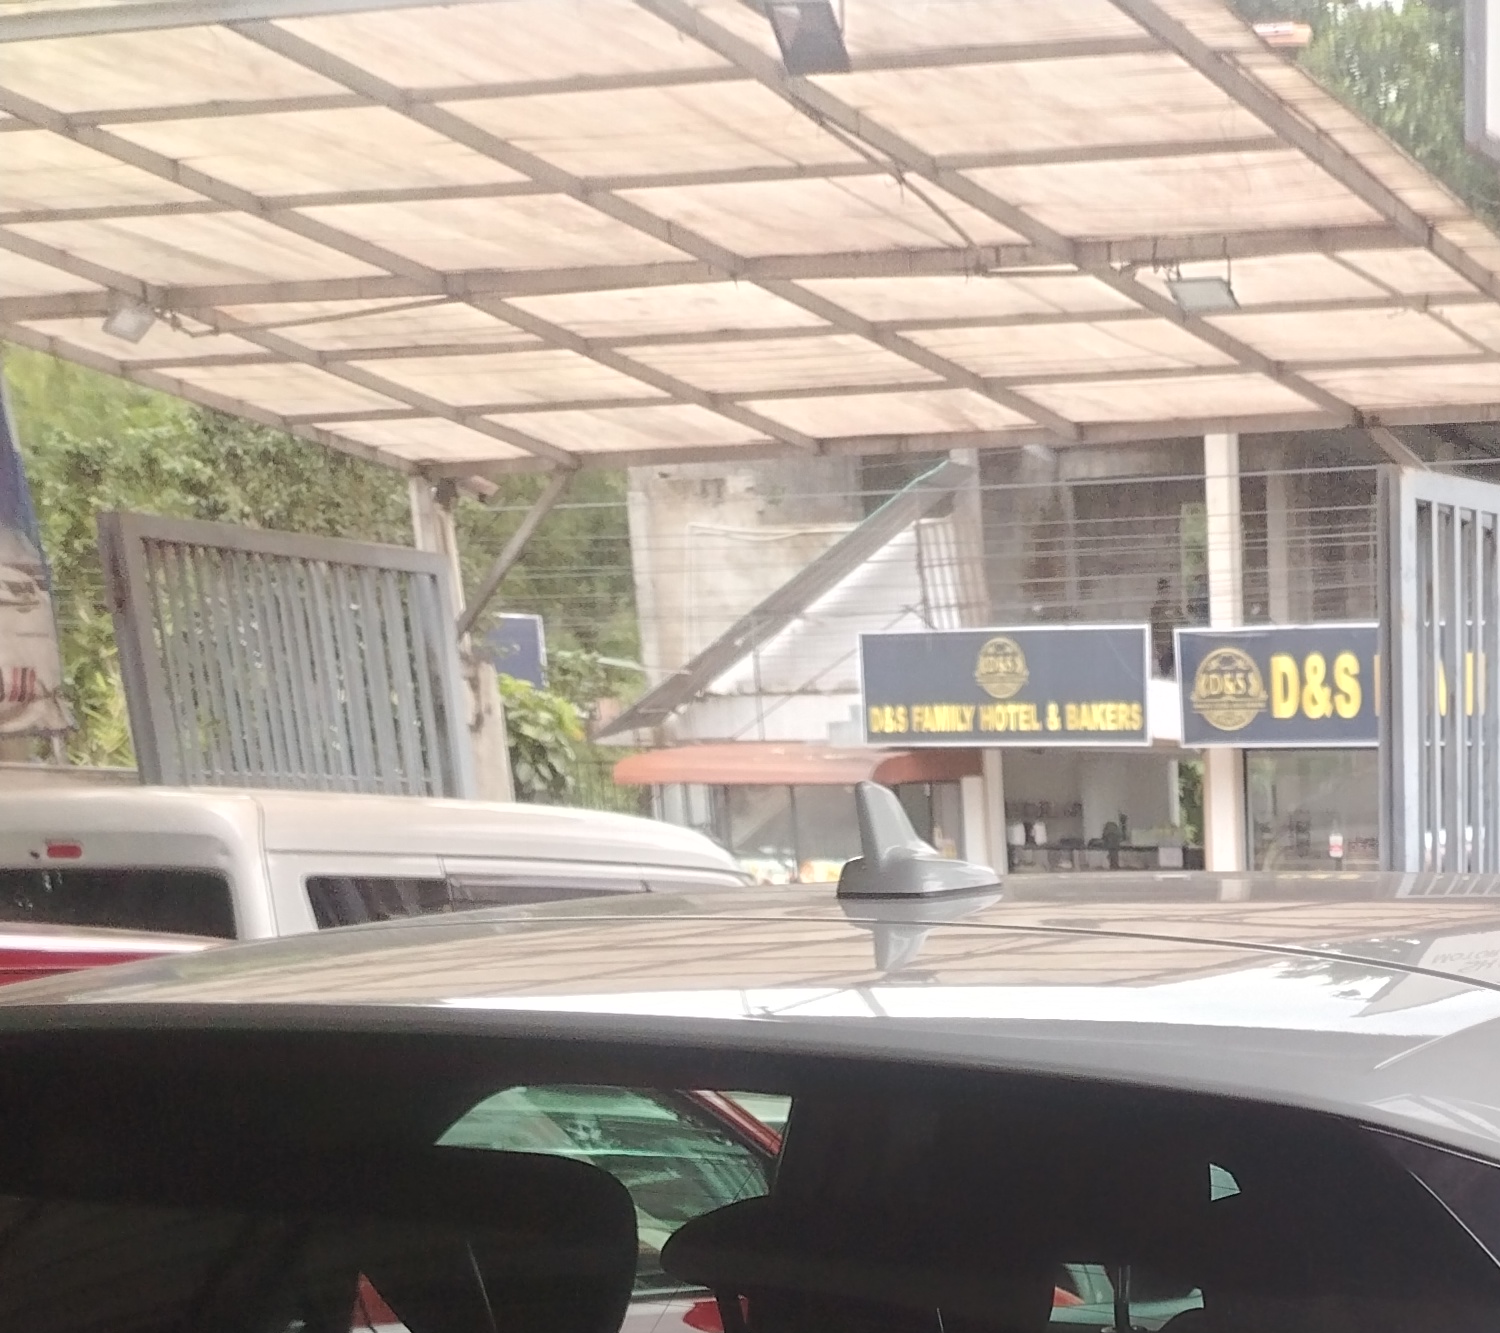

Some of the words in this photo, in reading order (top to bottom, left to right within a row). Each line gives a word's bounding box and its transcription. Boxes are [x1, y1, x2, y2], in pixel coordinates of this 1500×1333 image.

[1271, 653, 1362, 718] D&S
[869, 705, 909, 733] D&S
[911, 704, 976, 732] FAMILY
[979, 703, 1042, 731] HOTEL
[1045, 702, 1062, 731] &
[1064, 702, 1143, 731] BAKERS
